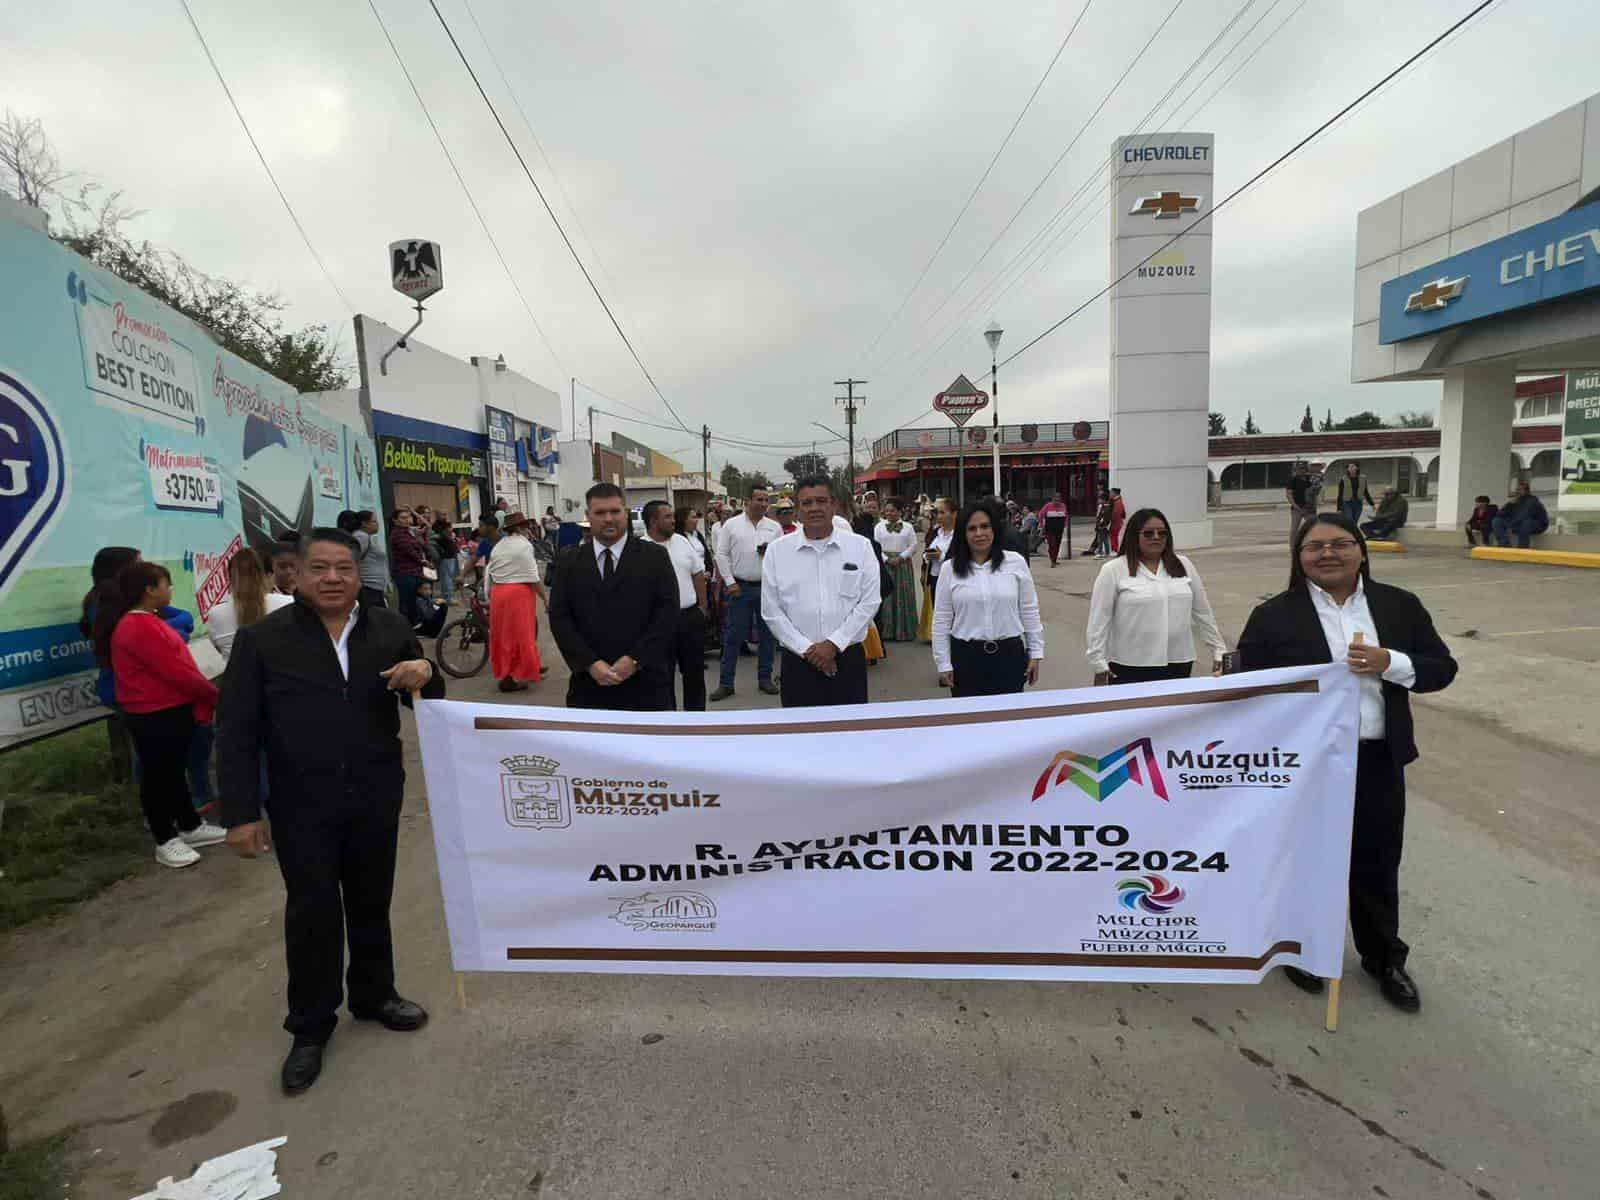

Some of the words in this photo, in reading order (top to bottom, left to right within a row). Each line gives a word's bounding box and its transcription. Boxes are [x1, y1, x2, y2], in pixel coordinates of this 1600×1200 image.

[1124, 146, 1210, 163] CHEVROLET
[96, 351, 135, 391] BEST
[140, 371, 195, 413] EDITION
[1575, 376, 1600, 390] MUL
[384, 441, 426, 471] Bebidas
[427, 447, 472, 479] Preparadas
[1167, 740, 1302, 772] Múzquiz
[571, 777, 645, 788] Gobierno
[648, 779, 668, 789] de
[1179, 773, 1233, 784] Somos
[1238, 771, 1291, 783] Todos
[573, 788, 721, 811] Múzquiz
[576, 805, 660, 816] 2022-2024
[695, 844, 737, 860] R.
[753, 824, 1130, 859] AYUNTAMIENTO
[588, 850, 974, 882] ADMINISTRACION
[990, 850, 1230, 873] 2022-2024
